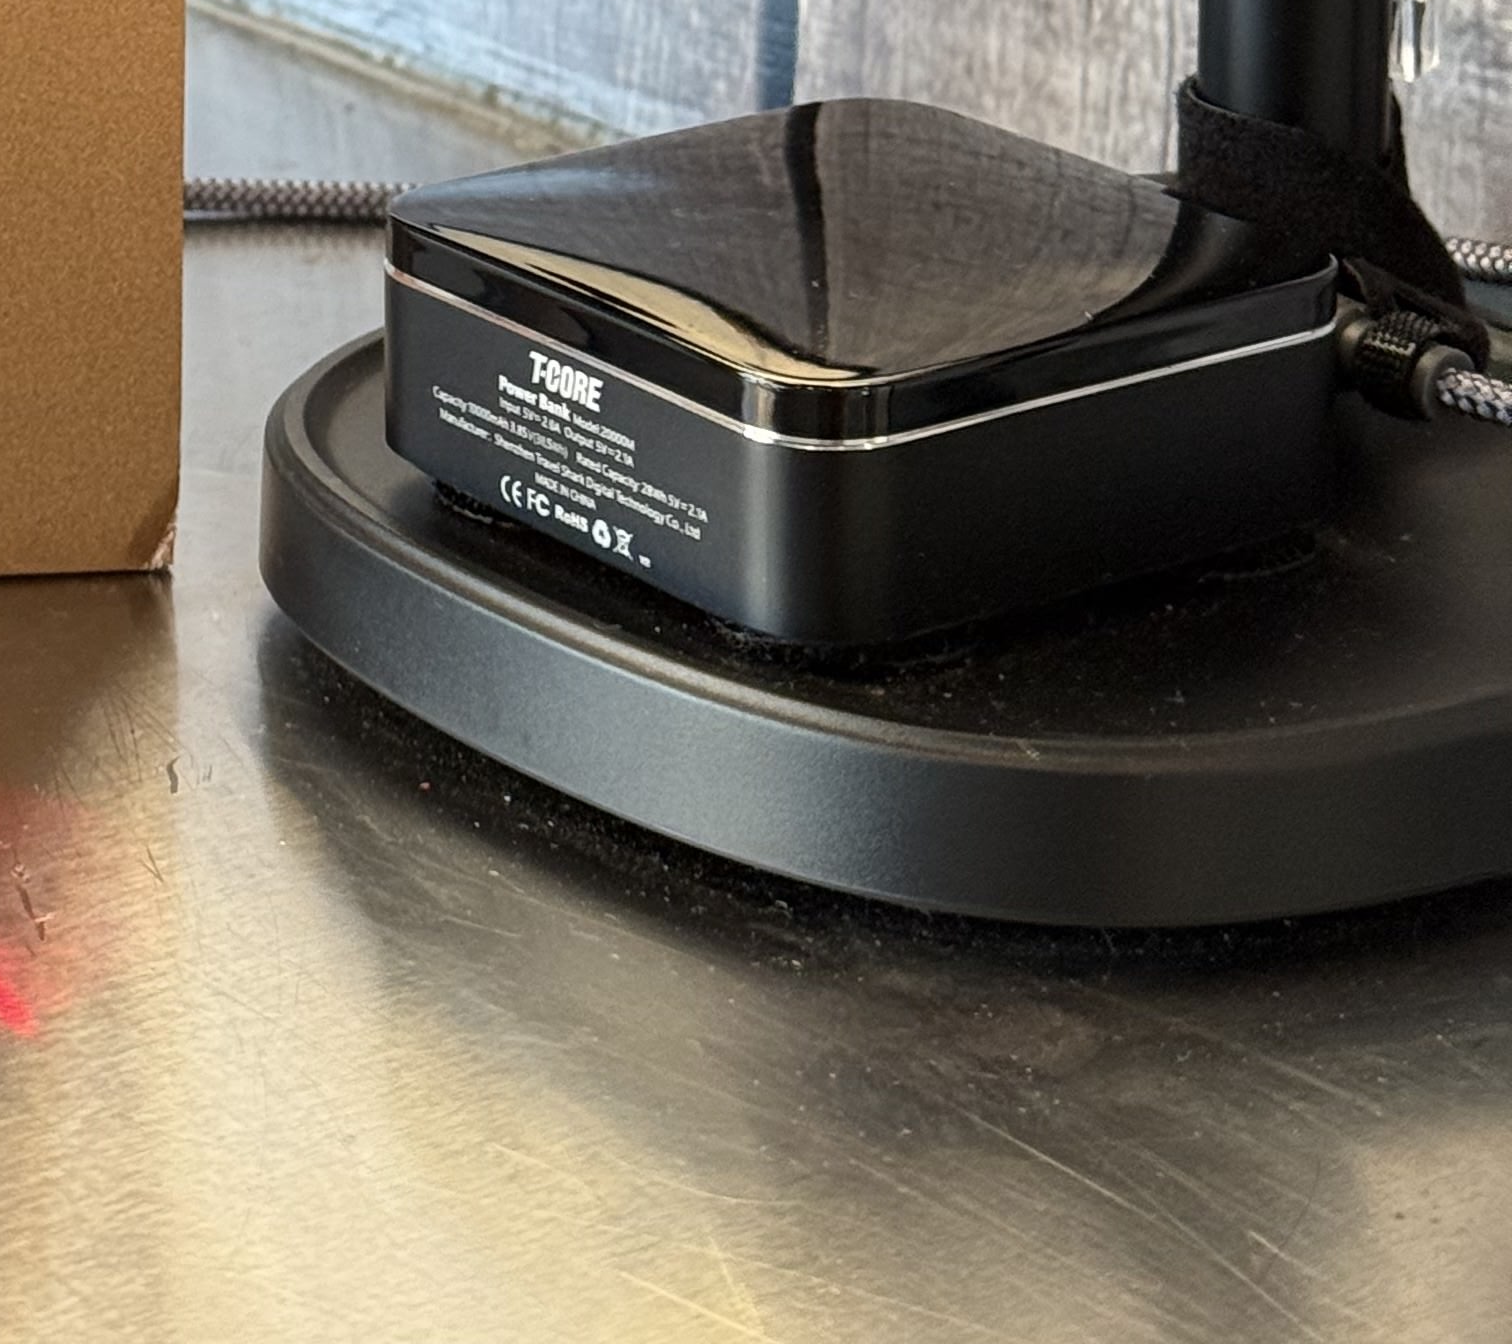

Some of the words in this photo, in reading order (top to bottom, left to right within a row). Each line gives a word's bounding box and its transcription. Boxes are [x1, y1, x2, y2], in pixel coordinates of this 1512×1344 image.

[498, 373, 536, 406] Power
[539, 391, 570, 421] Bank
[529, 351, 603, 412] T-CORE
[555, 505, 588, 532] RoHS
